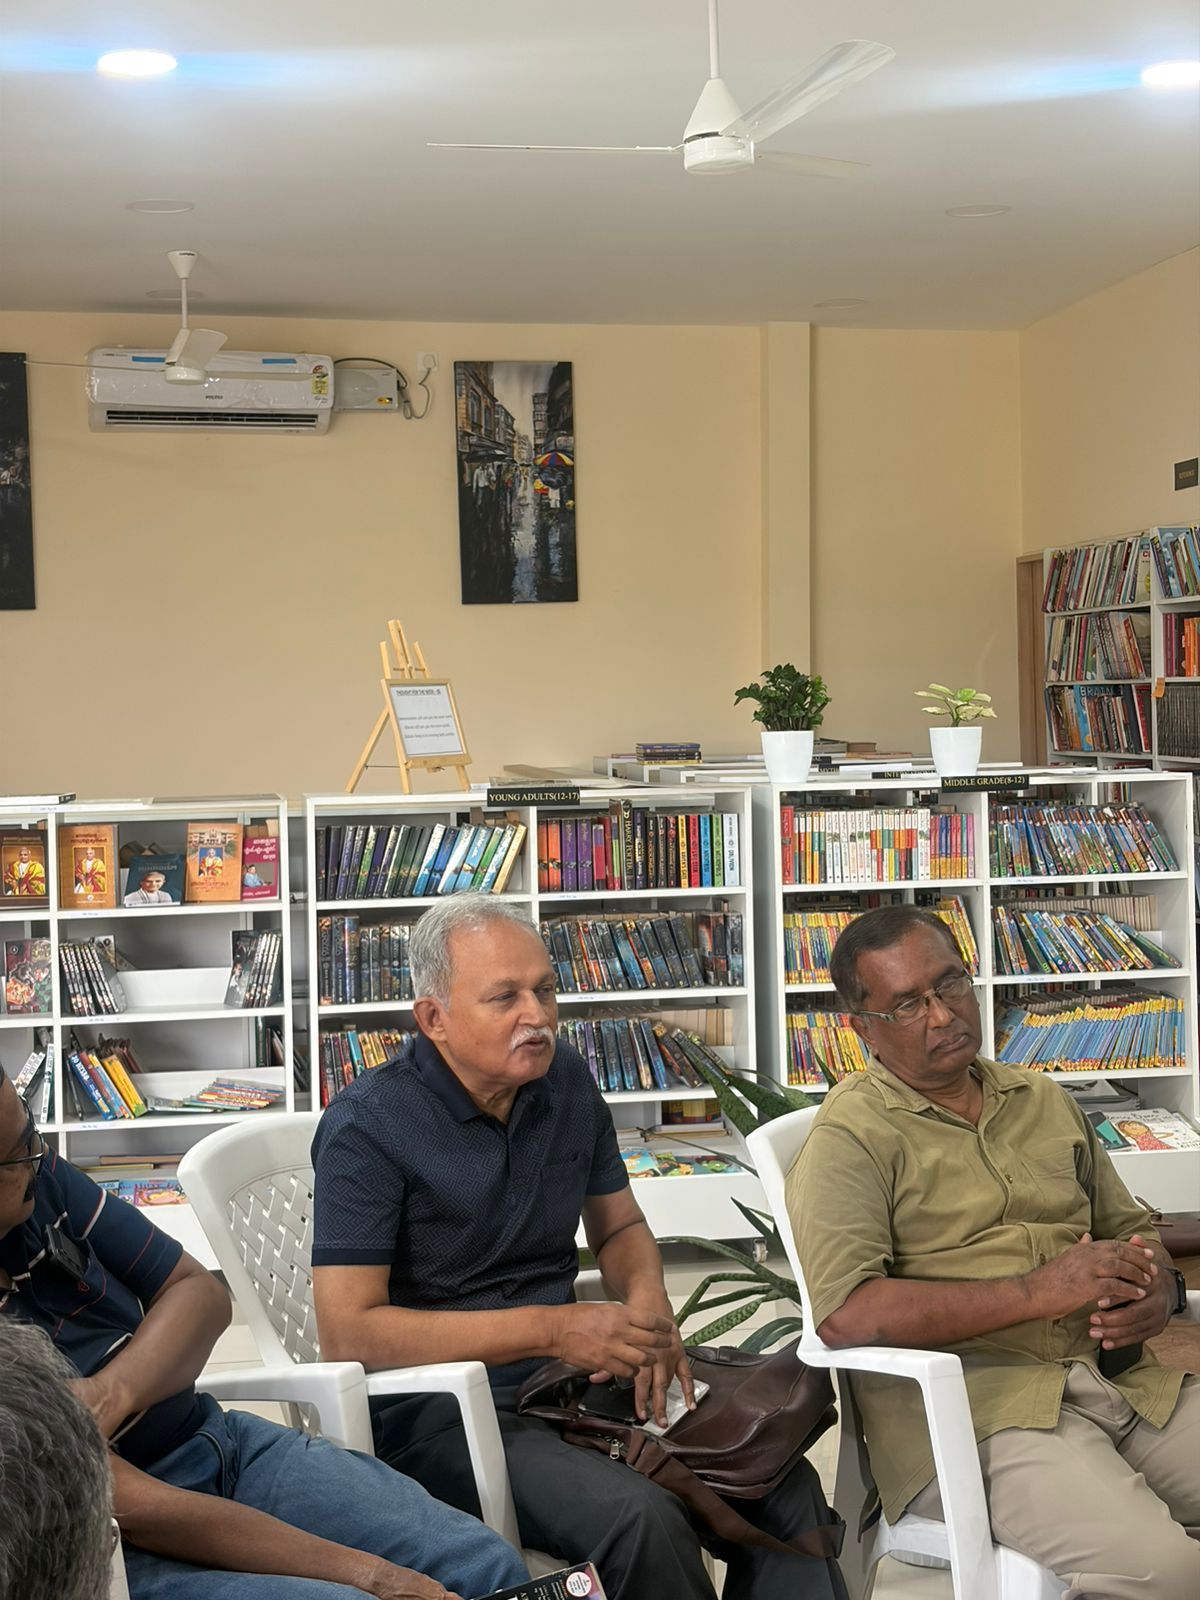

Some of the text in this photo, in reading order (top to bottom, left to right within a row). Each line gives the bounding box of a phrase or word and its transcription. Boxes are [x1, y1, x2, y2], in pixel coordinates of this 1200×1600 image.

[943, 776, 1025, 787] MIDDLE GRADE(8-12)
[489, 792, 580, 802] YOUNG ADULTS(12-17)
[624, 820, 633, 843] HARRY
